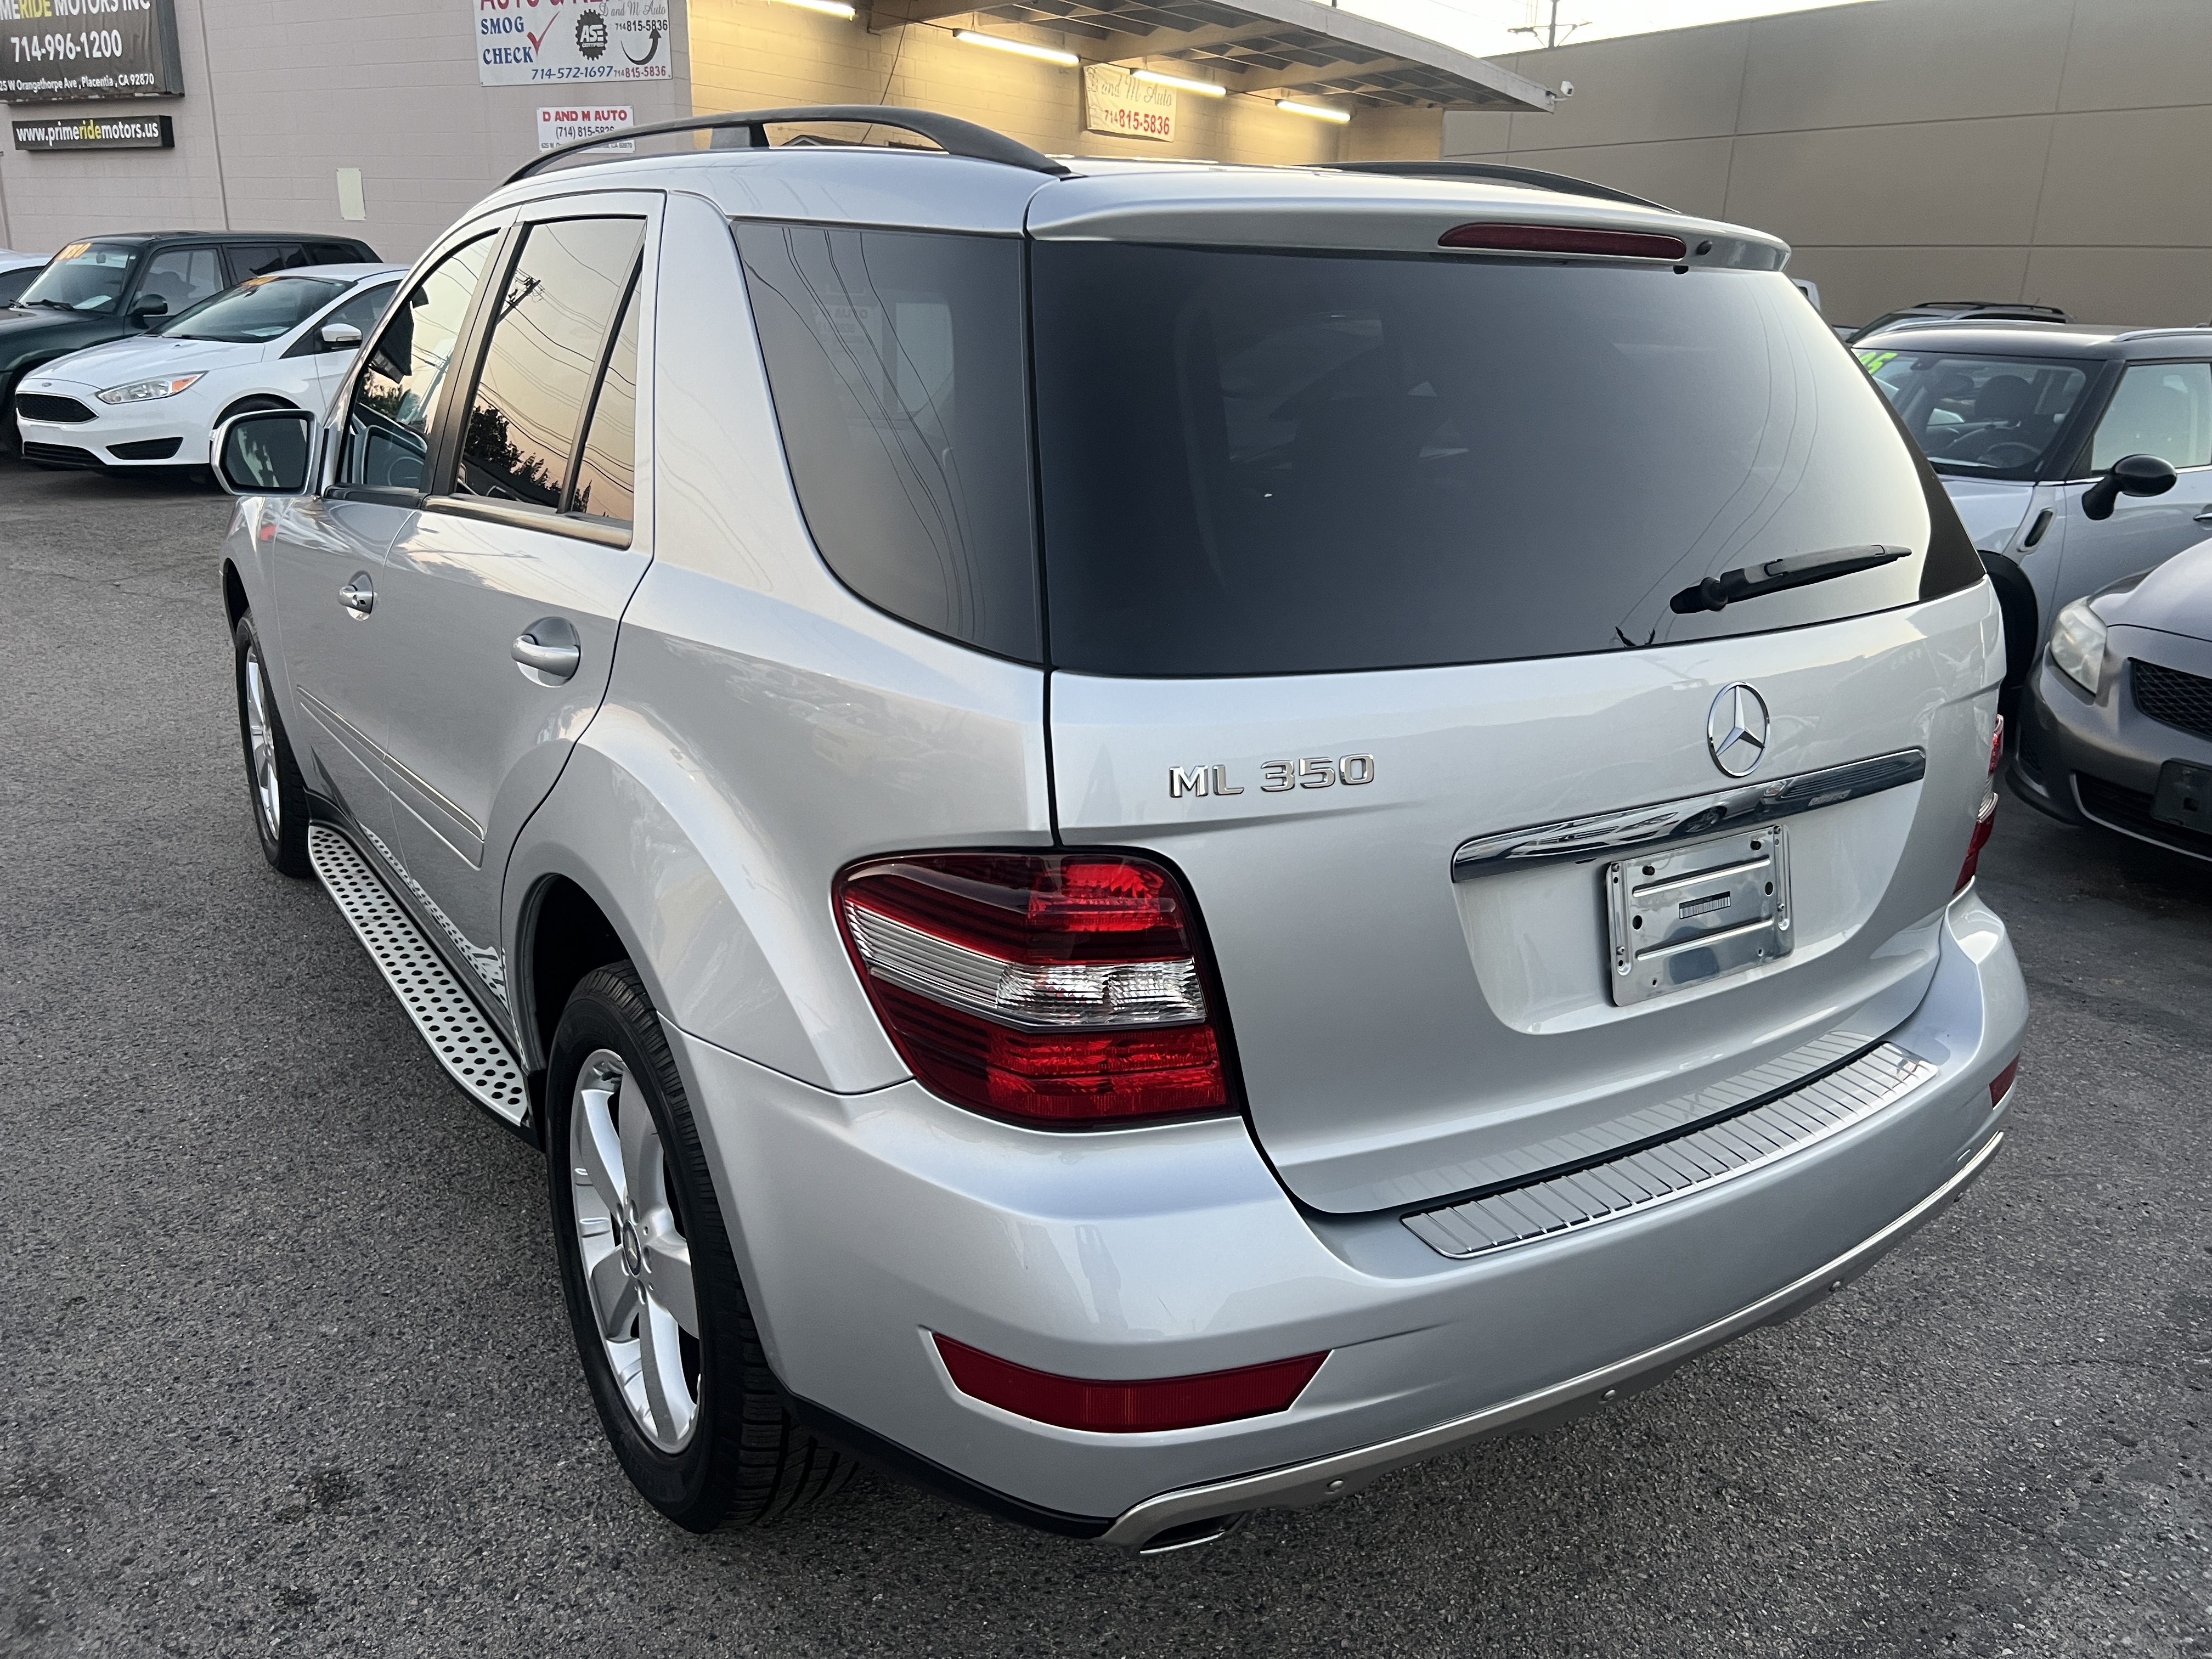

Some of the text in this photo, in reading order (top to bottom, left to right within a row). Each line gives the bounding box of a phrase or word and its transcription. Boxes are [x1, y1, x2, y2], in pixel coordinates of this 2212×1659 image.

[611, 2, 625, 16] and
[627, 1, 639, 15] M
[643, 0, 665, 15] Auto
[481, 16, 524, 35] SMOG
[580, 24, 603, 42] ASE
[10, 30, 122, 62] 714-996-1200
[483, 47, 533, 65] CHECK
[532, 65, 613, 80] 714-572-1697
[16, 77, 63, 93] Orangethorpe
[119, 74, 129, 86] CA
[130, 73, 154, 85] 92870
[543, 110, 628, 122] D AND M AUTO
[16, 119, 159, 146] www.primeridemotors.us
[556, 126, 575, 139] (714)
[1169, 753, 1374, 798] ML 350
